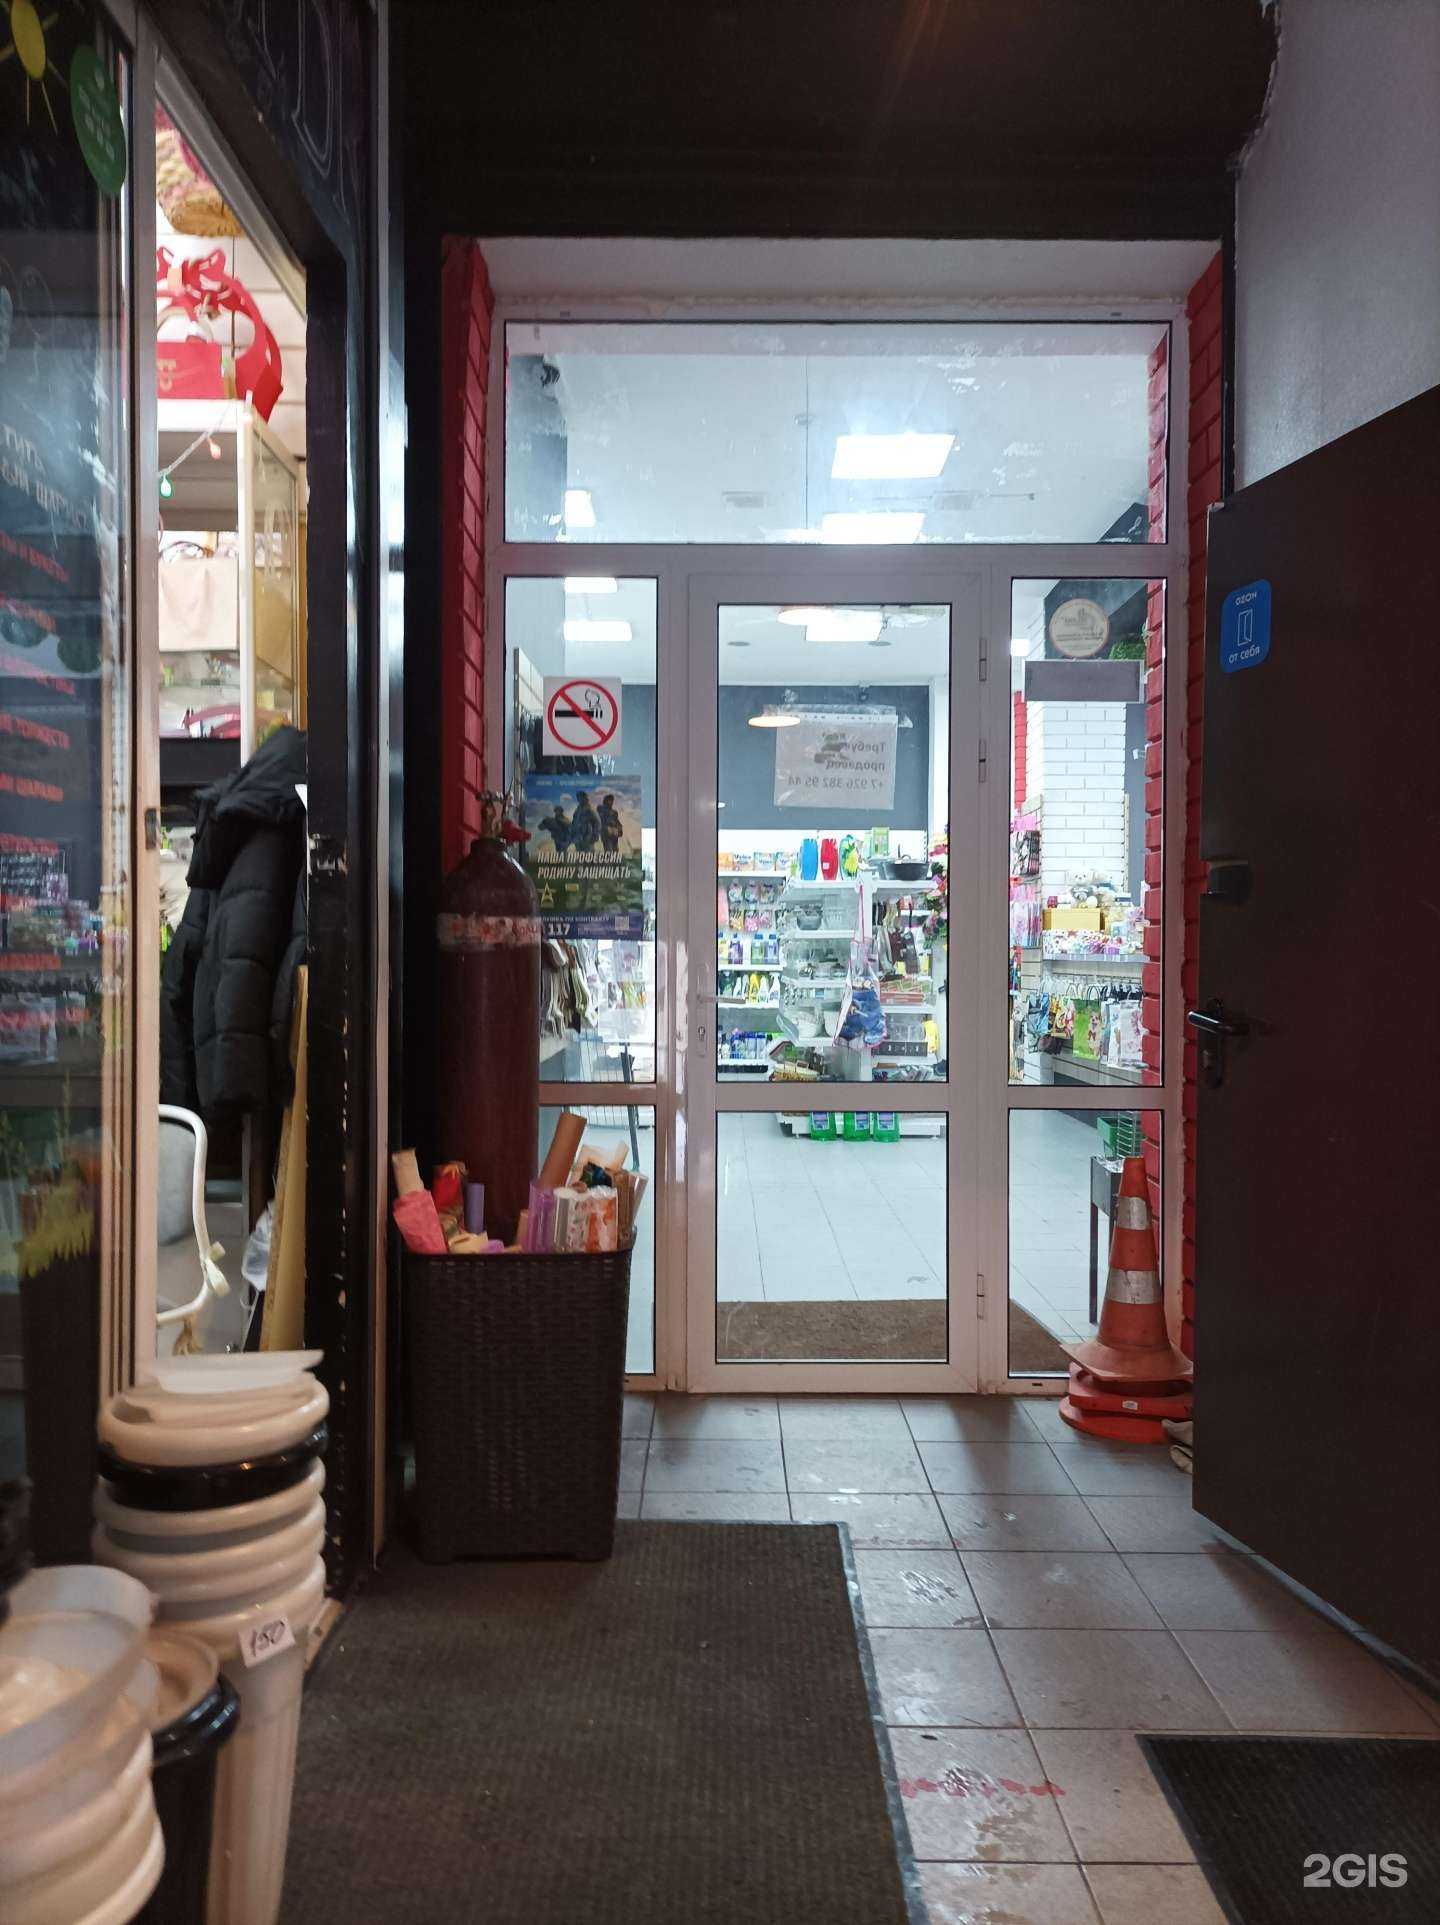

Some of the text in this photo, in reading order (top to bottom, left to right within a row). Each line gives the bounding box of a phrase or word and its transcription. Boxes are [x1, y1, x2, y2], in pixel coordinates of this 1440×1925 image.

[1240, 644, 1260, 660] себя
[537, 850, 565, 864] НАША
[537, 865, 632, 880] РОДИНУ ЗАЩИЩАТЬ
[547, 922, 571, 936] 117
